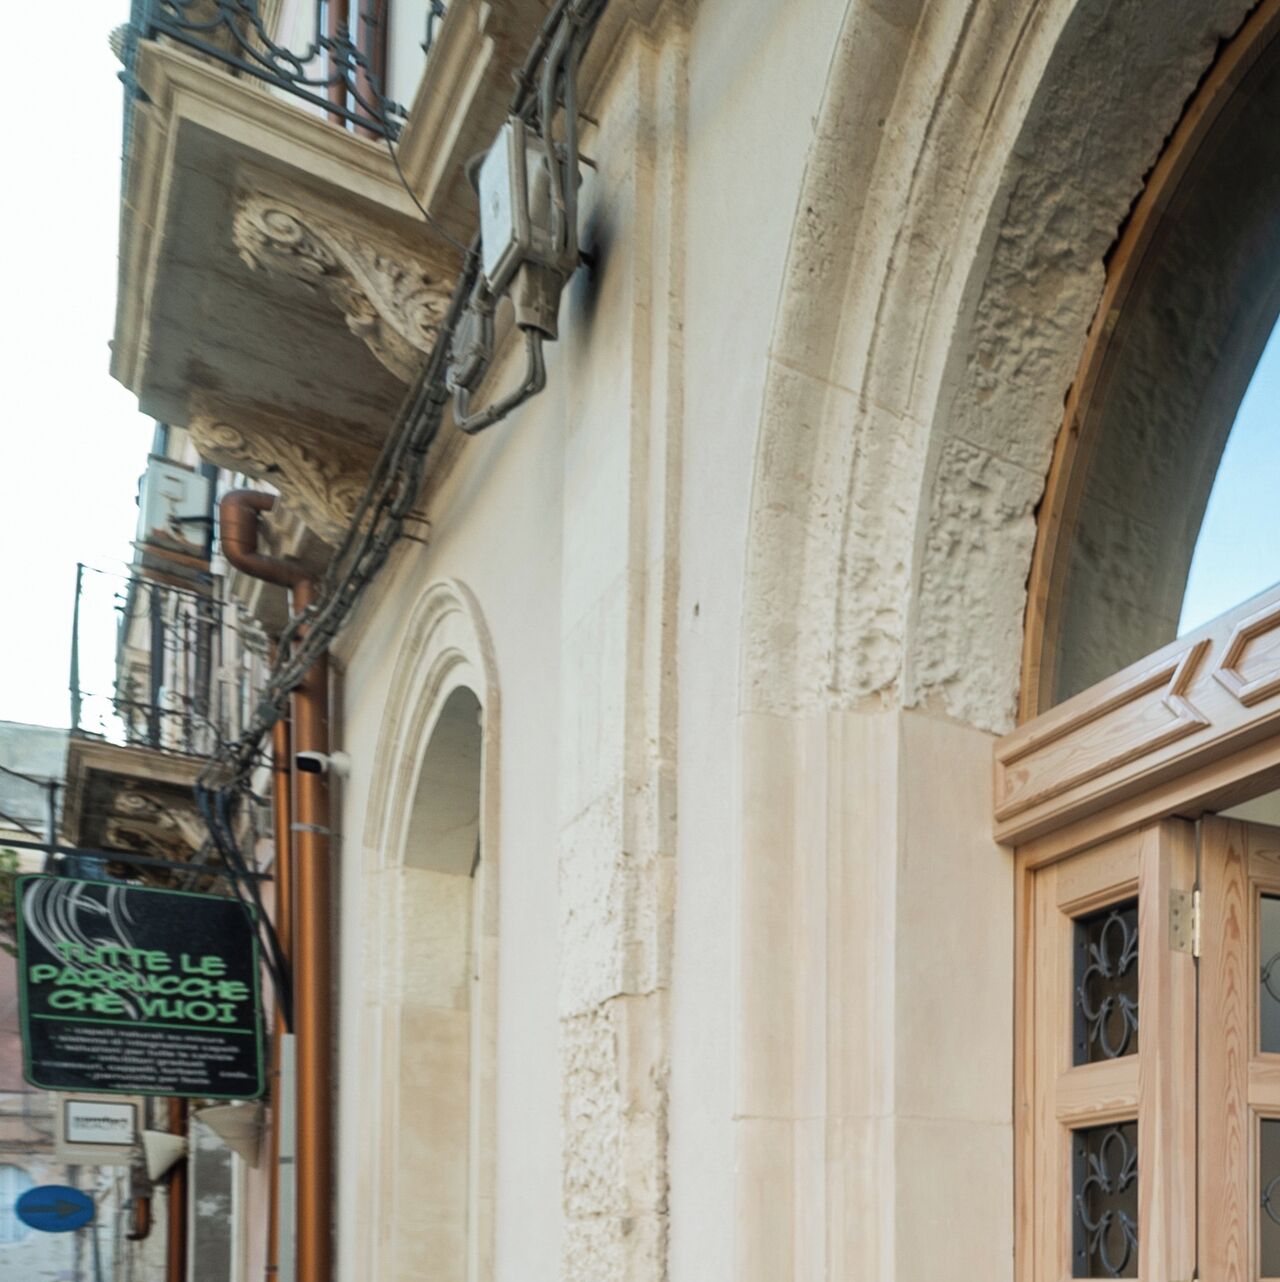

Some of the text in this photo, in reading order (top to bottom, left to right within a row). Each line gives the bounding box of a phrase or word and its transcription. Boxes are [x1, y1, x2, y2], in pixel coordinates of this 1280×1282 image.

[57, 941, 228, 976] TUTTE LE
[29, 964, 250, 1001] PARRUCCHE
[47, 989, 238, 1023] CHE VUOI
